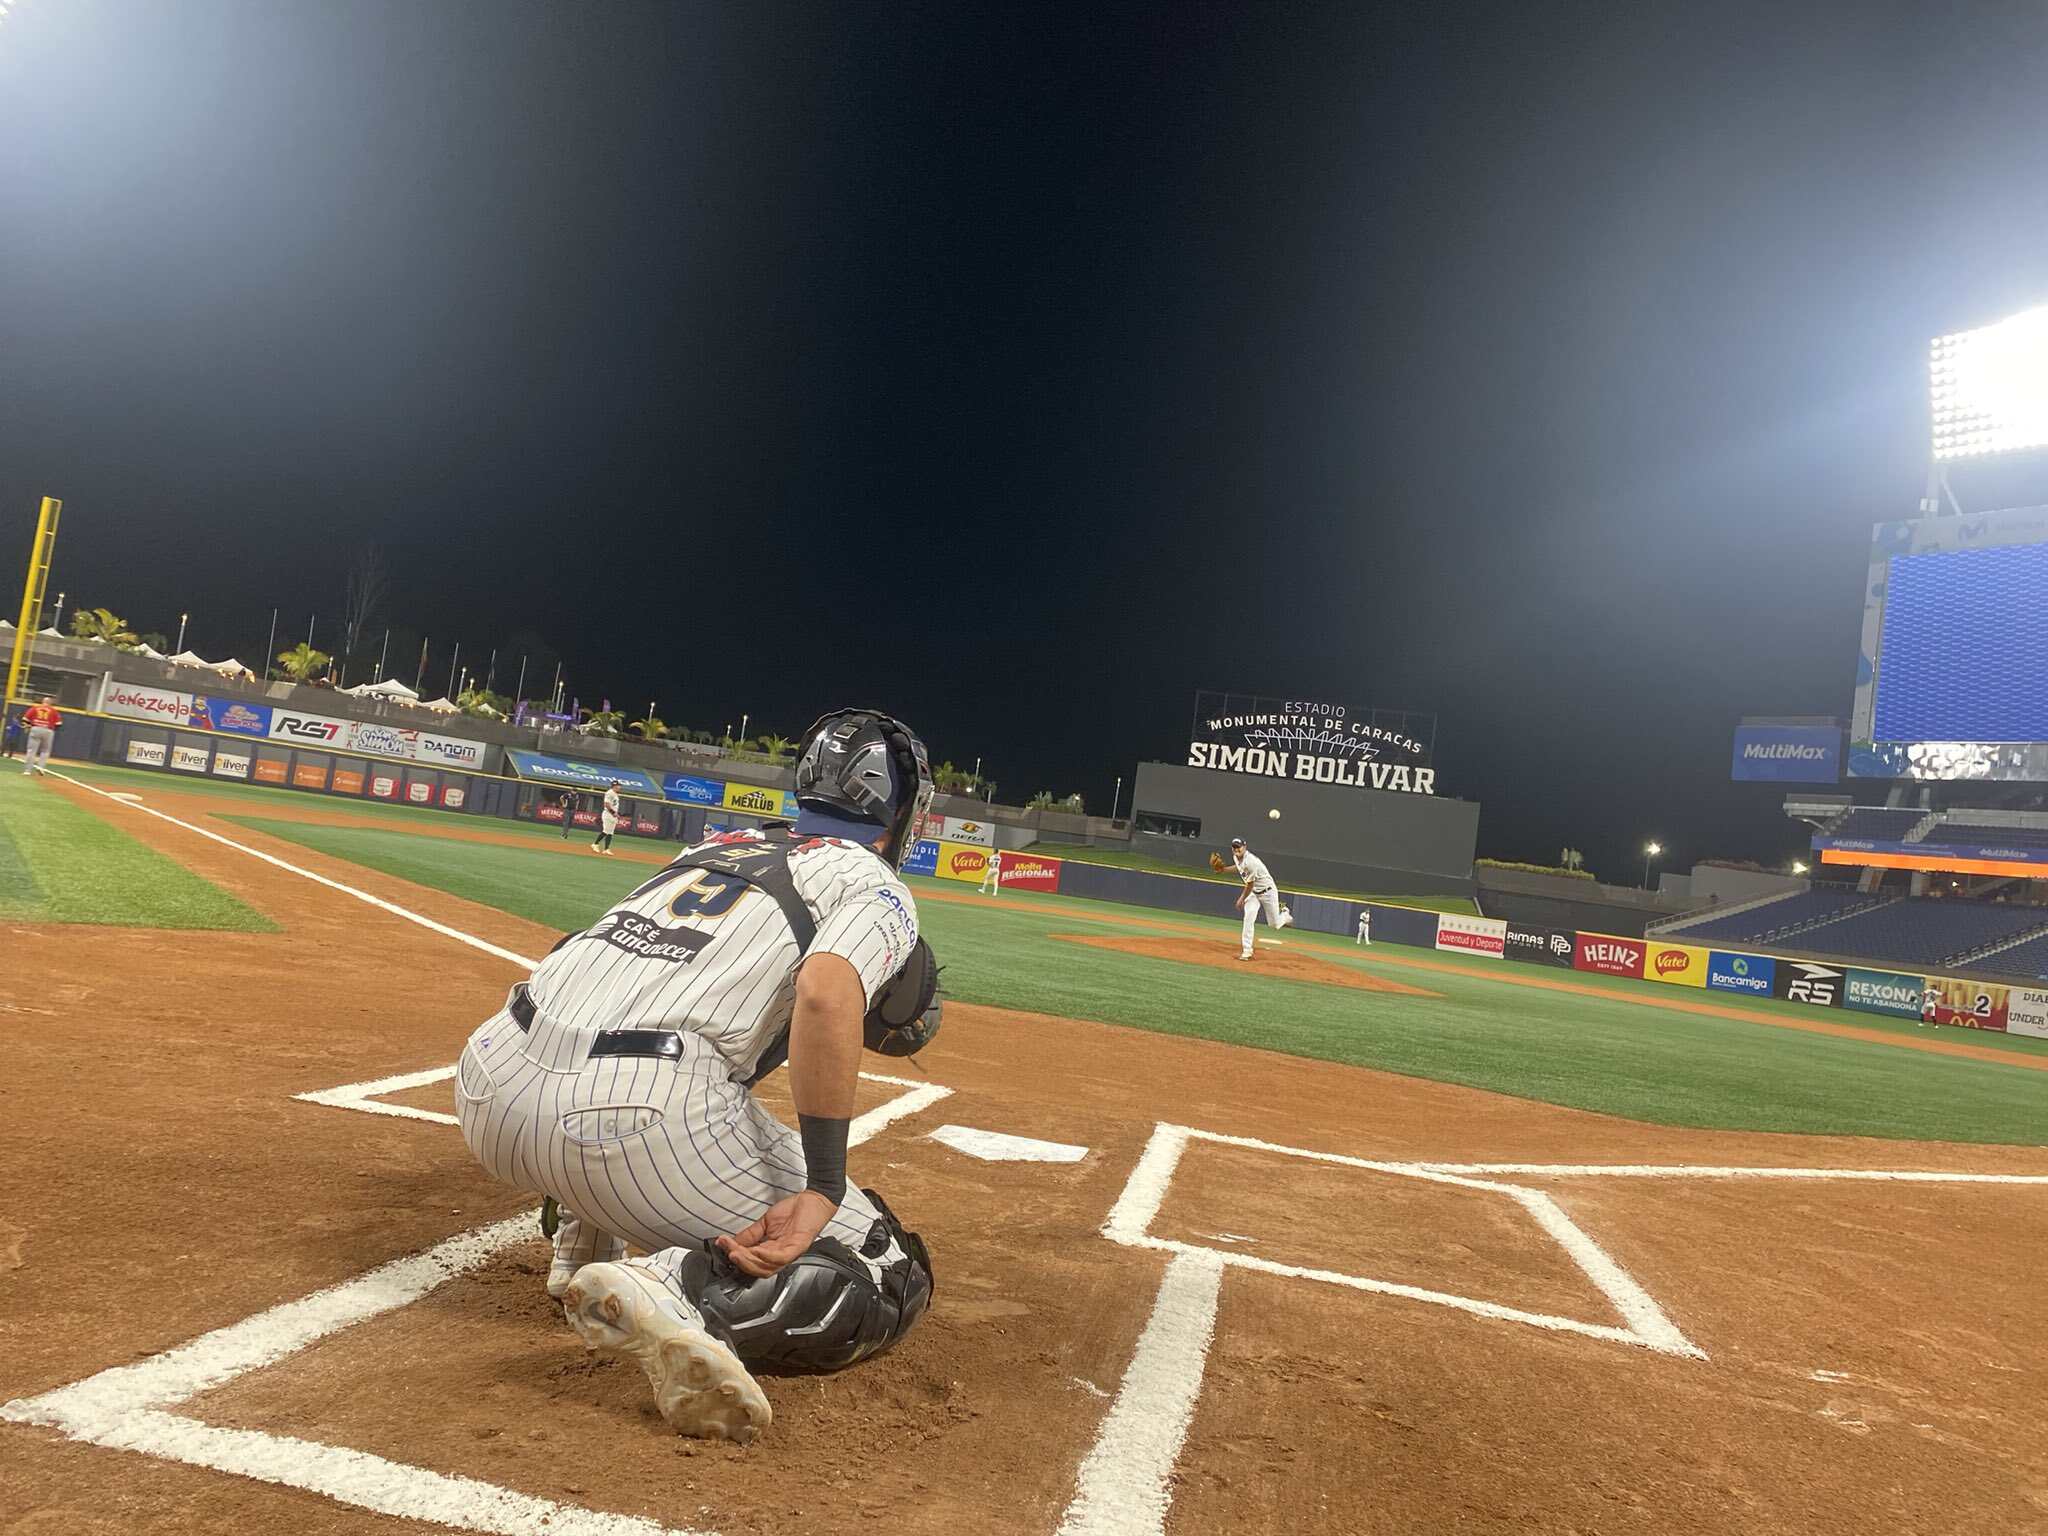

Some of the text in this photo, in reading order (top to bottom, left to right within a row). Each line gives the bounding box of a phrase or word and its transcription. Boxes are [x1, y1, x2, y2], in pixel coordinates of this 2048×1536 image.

[1285, 701, 1346, 718] ESTADIO
[1209, 714, 1422, 754] MONUMENTAL DE CARACAS
[136, 746, 165, 760] ilven
[180, 751, 208, 767] ilven
[1743, 743, 1826, 760] MultiMax
[223, 759, 249, 772] ilven
[1187, 742, 1436, 795] SIMÓN BOLÍVAR
[731, 795, 774, 812] MEXLUB
[953, 855, 984, 868] Vatel
[1001, 869, 1056, 881] REGIONAL
[623, 918, 661, 943] CAFÉ
[1506, 931, 1544, 945] RIMAS
[1439, 931, 1470, 945] Juventud
[1475, 936, 1503, 950] Deporte
[1583, 944, 1640, 969] HEINZ
[1656, 954, 1688, 968] Vatel
[1712, 972, 1768, 990] Bancamiga
[1850, 981, 1918, 1004] REXONA
[1848, 995, 1918, 1012] NO TE ABANDONA
[1975, 994, 1991, 1016] 2
[2009, 1011, 2045, 1025] UNDER
